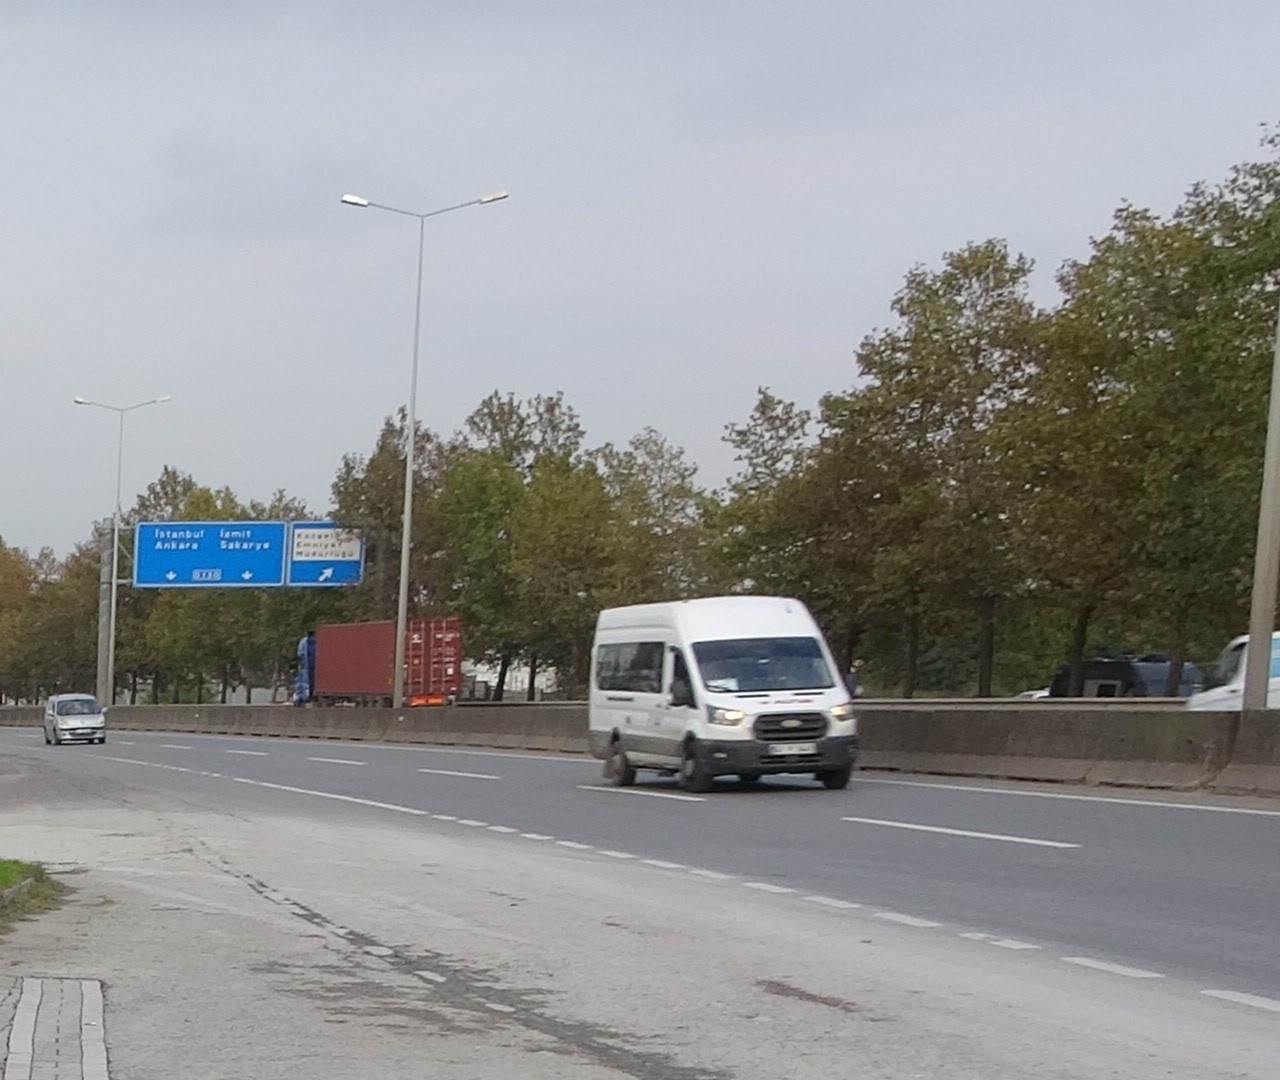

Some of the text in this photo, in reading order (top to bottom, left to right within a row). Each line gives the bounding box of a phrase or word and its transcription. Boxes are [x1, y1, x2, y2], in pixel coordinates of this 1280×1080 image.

[155, 529, 204, 539] İstanbul
[220, 529, 251, 539] İzmit
[155, 541, 198, 550] Ankara
[220, 541, 270, 551] Sakarya
